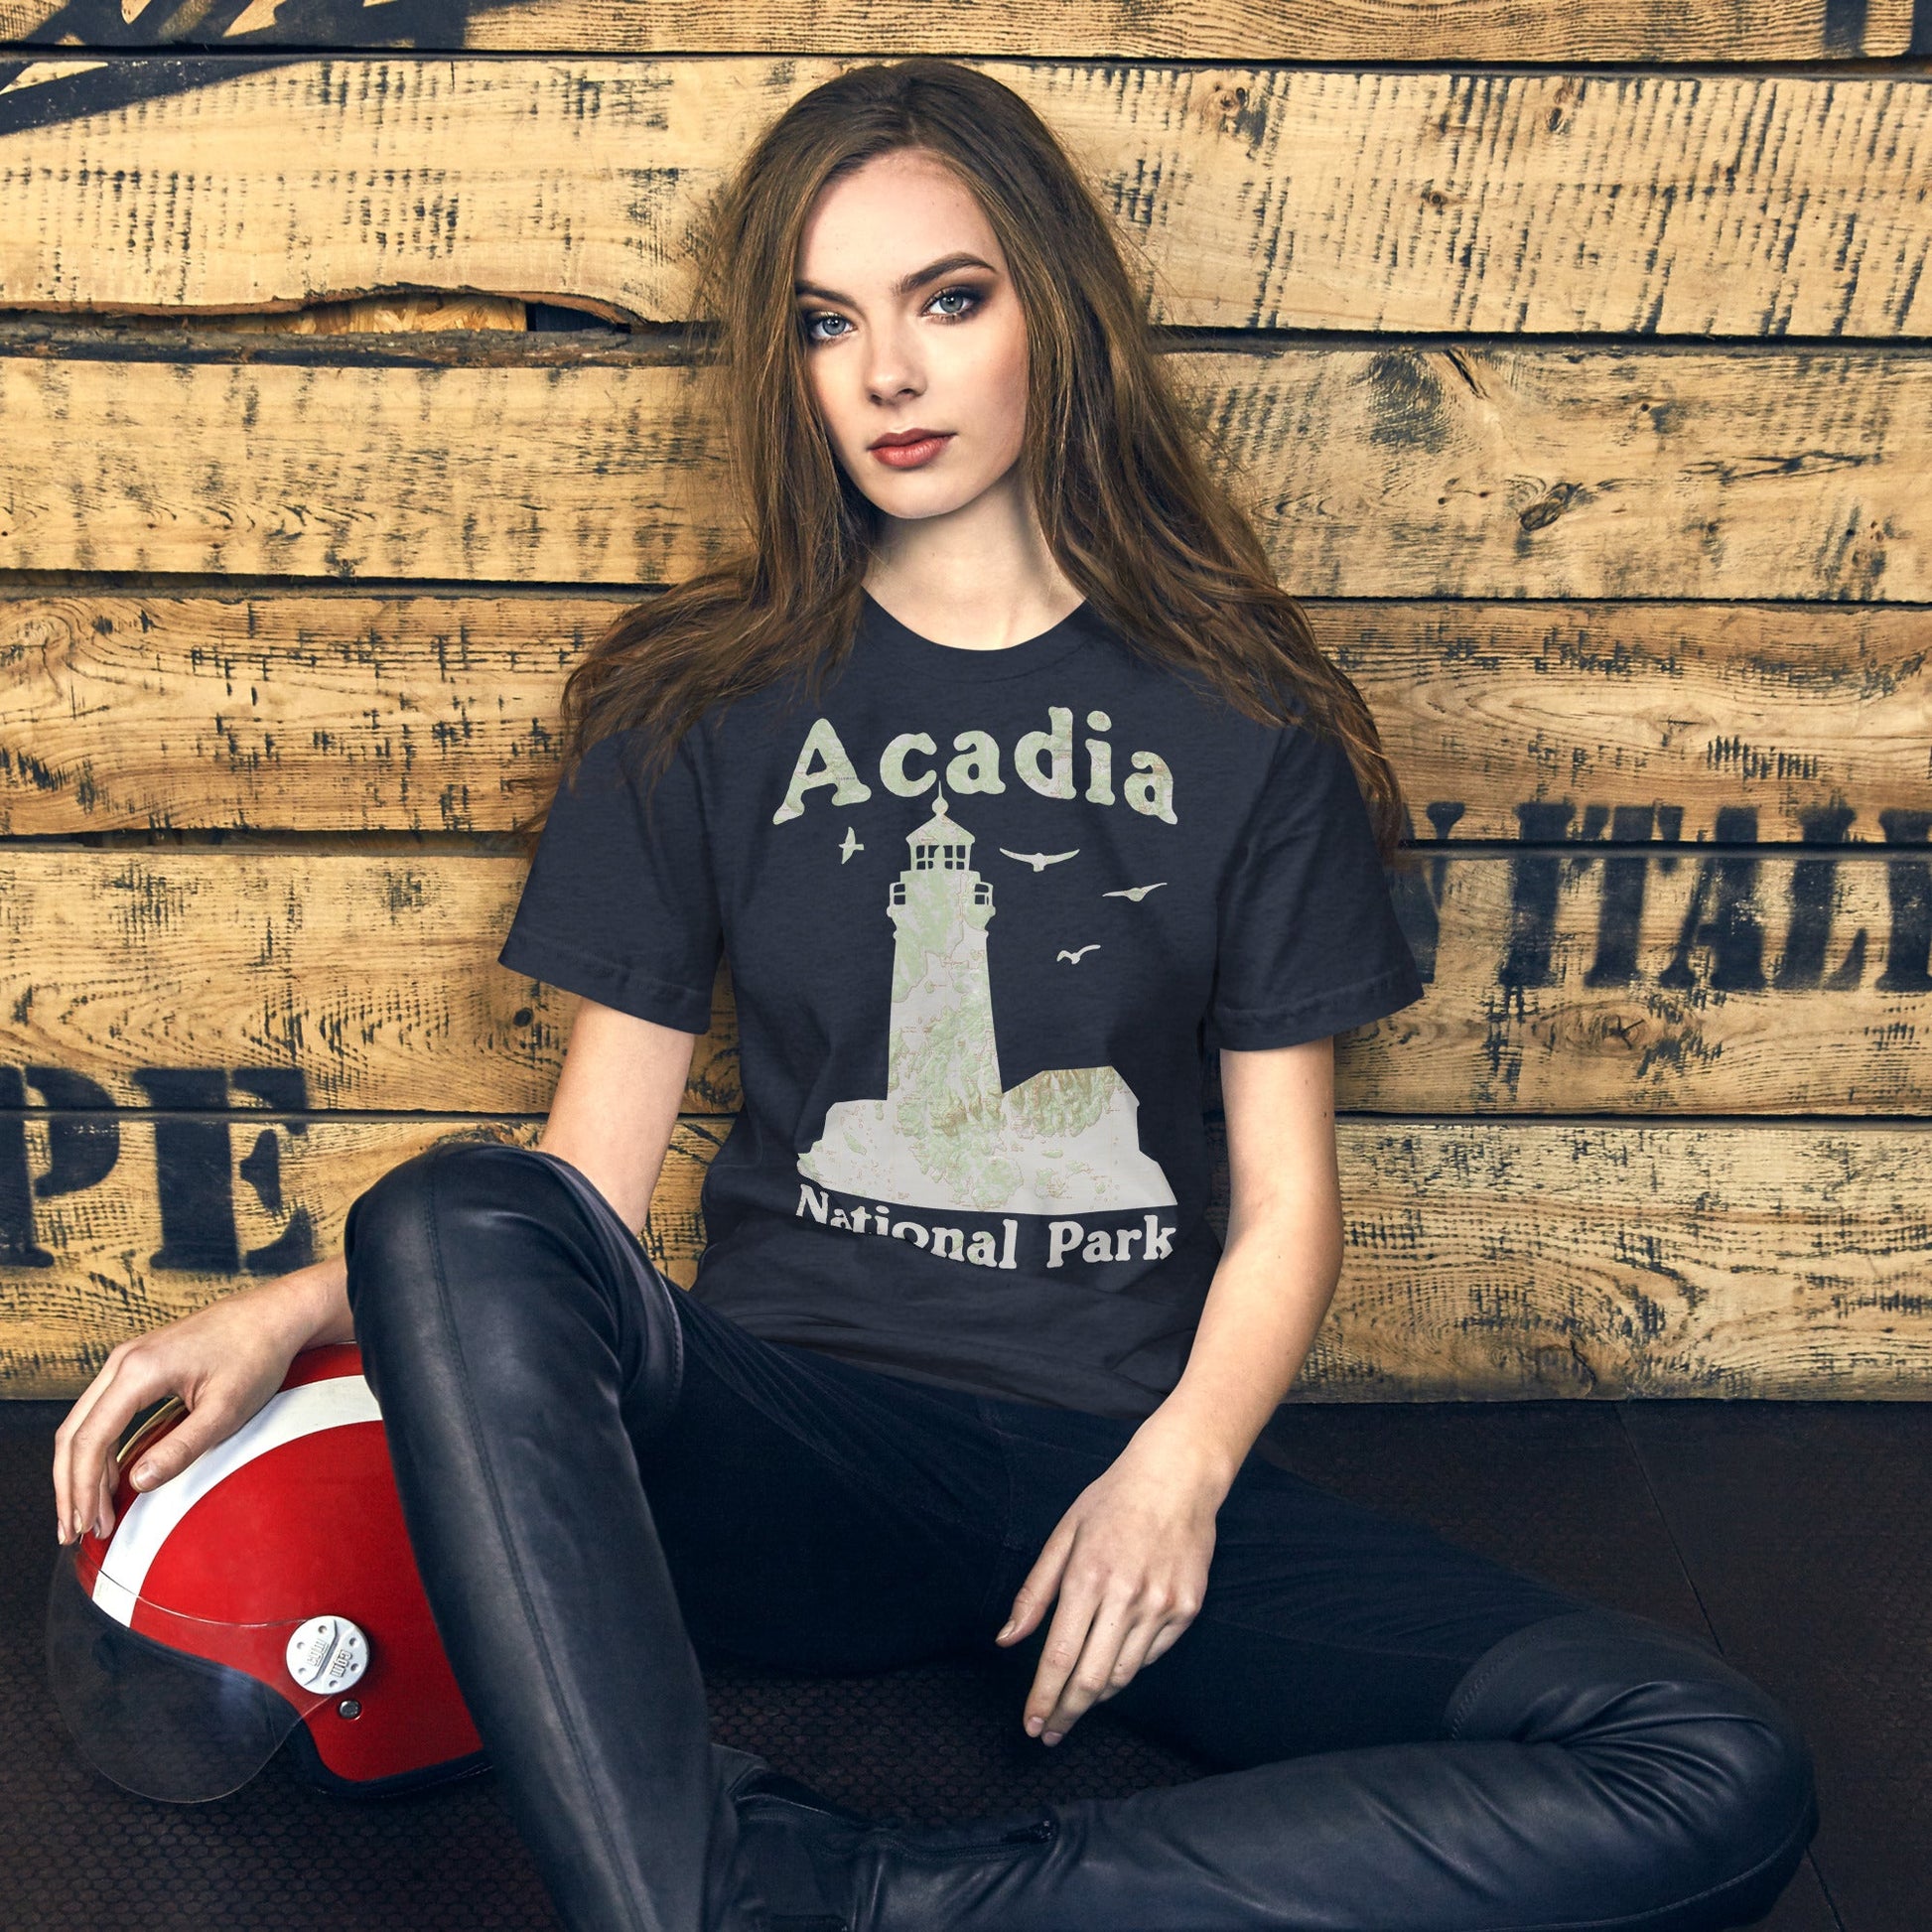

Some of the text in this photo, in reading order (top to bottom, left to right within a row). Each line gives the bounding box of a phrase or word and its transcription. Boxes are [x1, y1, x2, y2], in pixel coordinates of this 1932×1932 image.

[772, 706, 1178, 825] Acadia
[795, 1183, 1176, 1270] National Park
